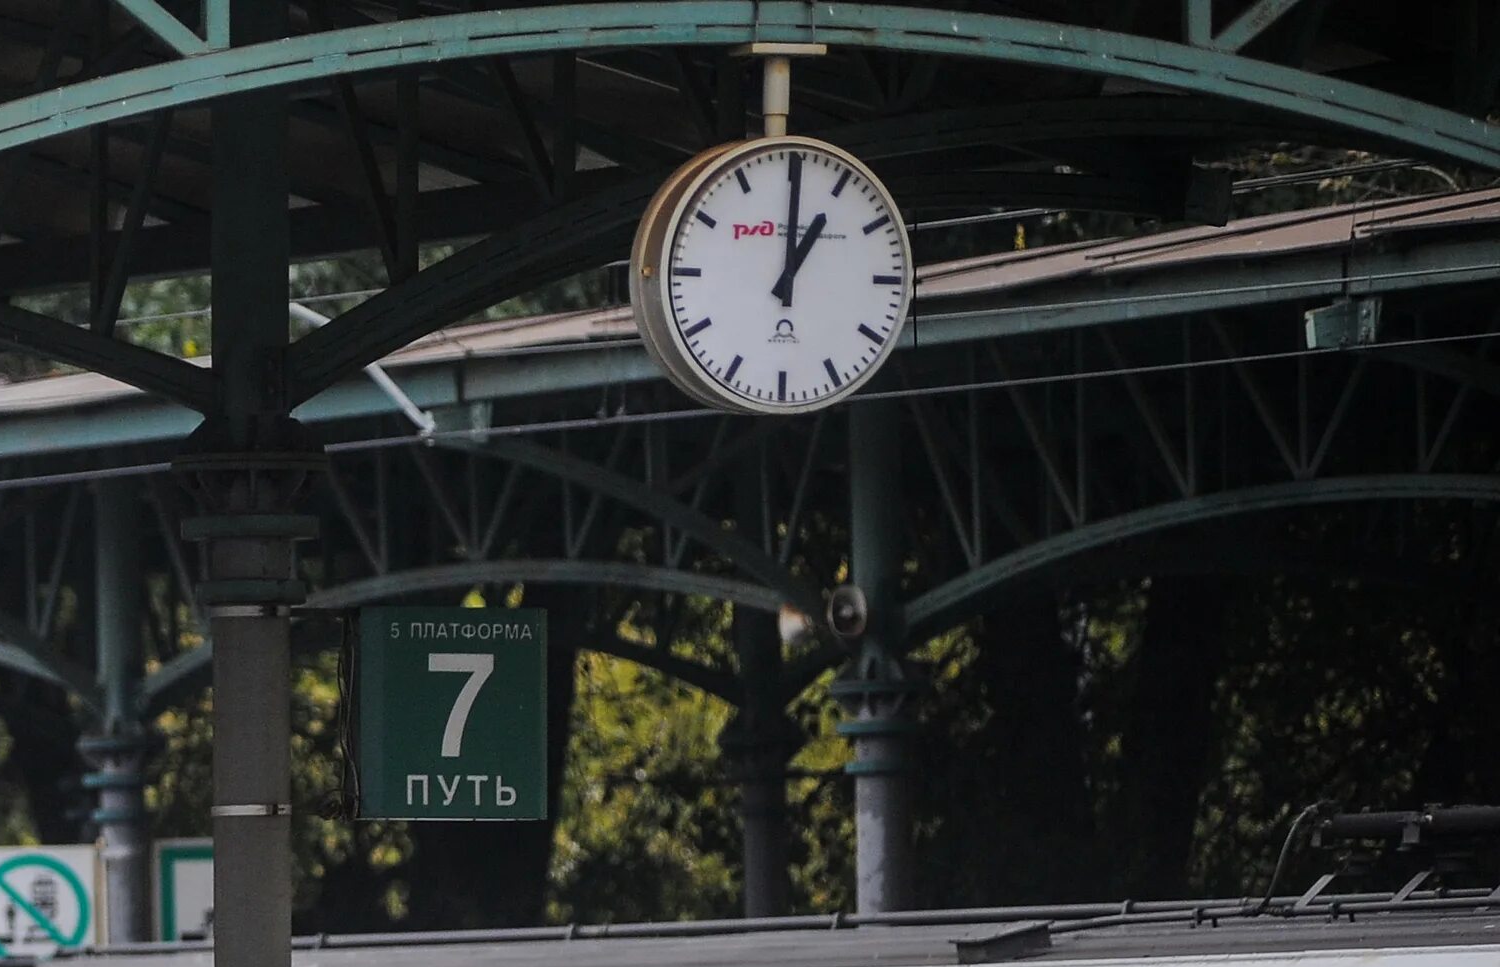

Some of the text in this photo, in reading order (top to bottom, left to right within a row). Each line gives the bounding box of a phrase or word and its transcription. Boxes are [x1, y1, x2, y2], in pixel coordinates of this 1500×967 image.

[390, 622, 533, 640] 5 ПЛАТФОРМА
[428, 653, 494, 757] 7
[406, 774, 517, 806] ПУТЬ
